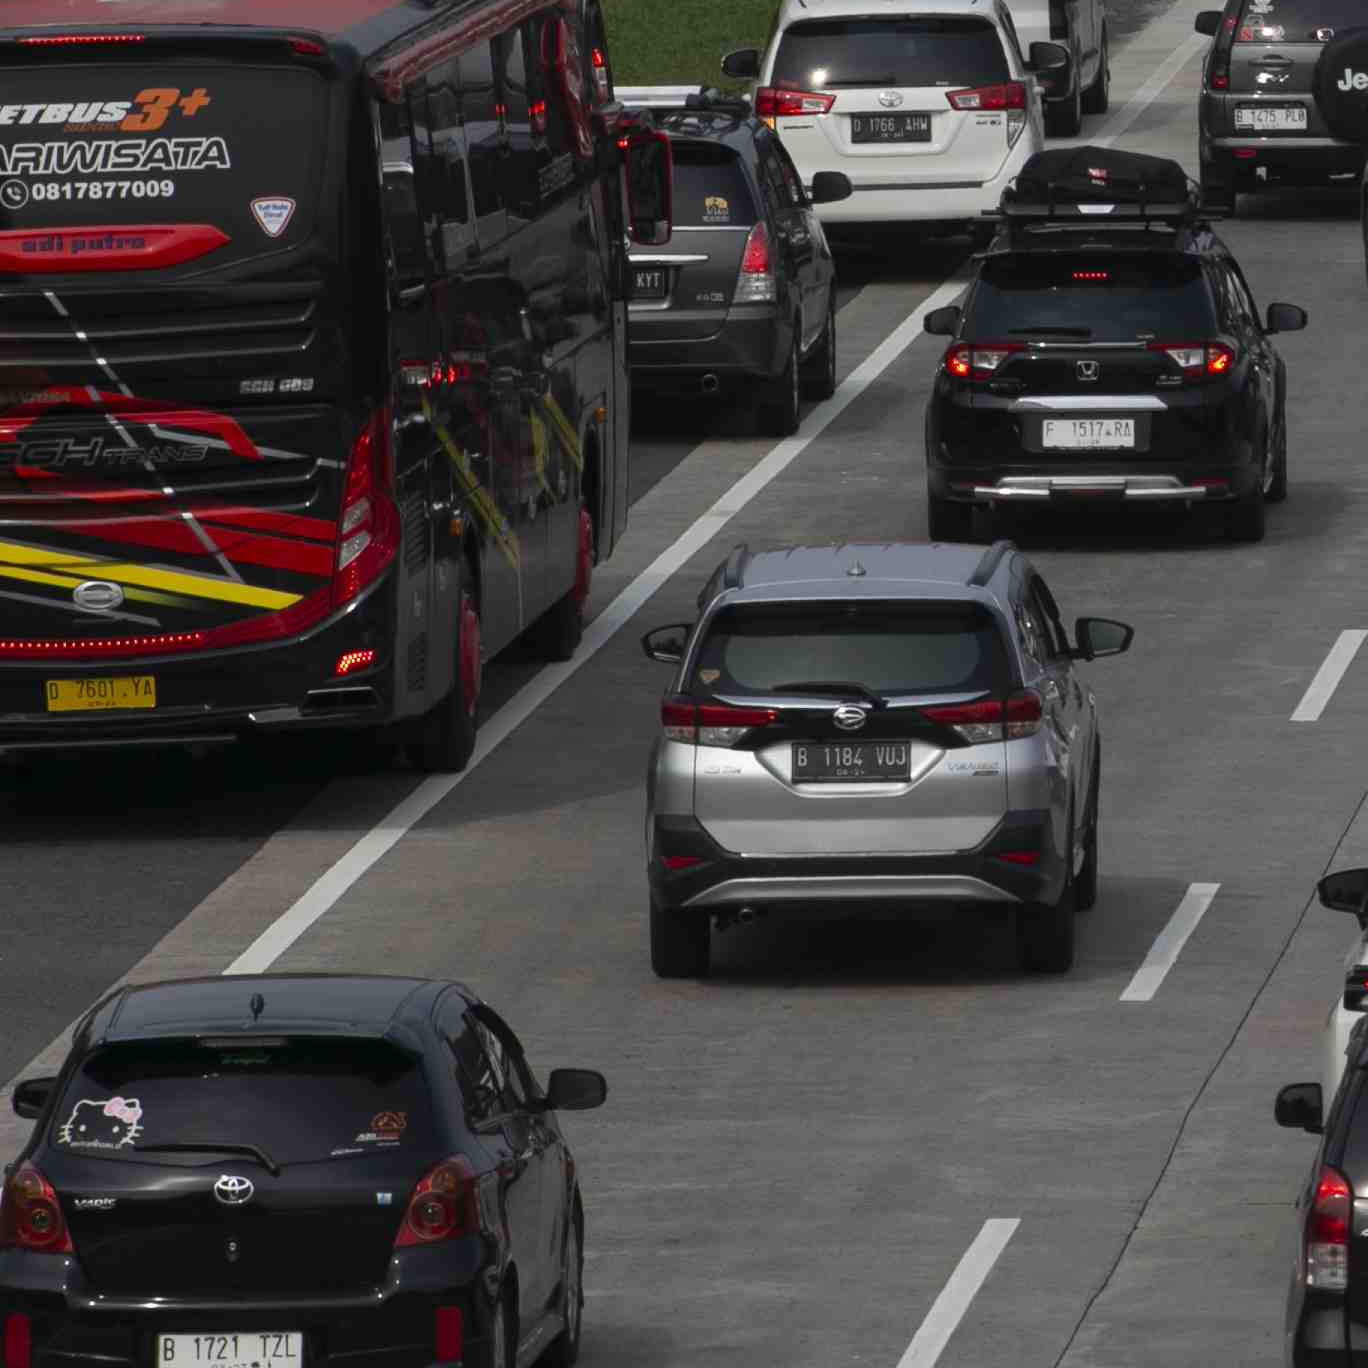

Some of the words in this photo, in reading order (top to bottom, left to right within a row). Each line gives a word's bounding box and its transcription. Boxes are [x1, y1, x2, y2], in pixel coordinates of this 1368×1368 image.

[32, 181, 174, 200] 0817877009
[636, 272, 661, 288] KYT
[1046, 421, 1055, 436] F
[1072, 421, 1104, 437] 1517
[50, 682, 58, 700] D
[77, 680, 115, 699] 7601
[132, 678, 153, 697] YA
[798, 748, 808, 767] B
[824, 747, 863, 767] 1184
[874, 745, 906, 766] VUJ
[163, 1337, 175, 1361] B
[193, 1335, 239, 1361] 1721
[259, 1334, 297, 1358] TZL
